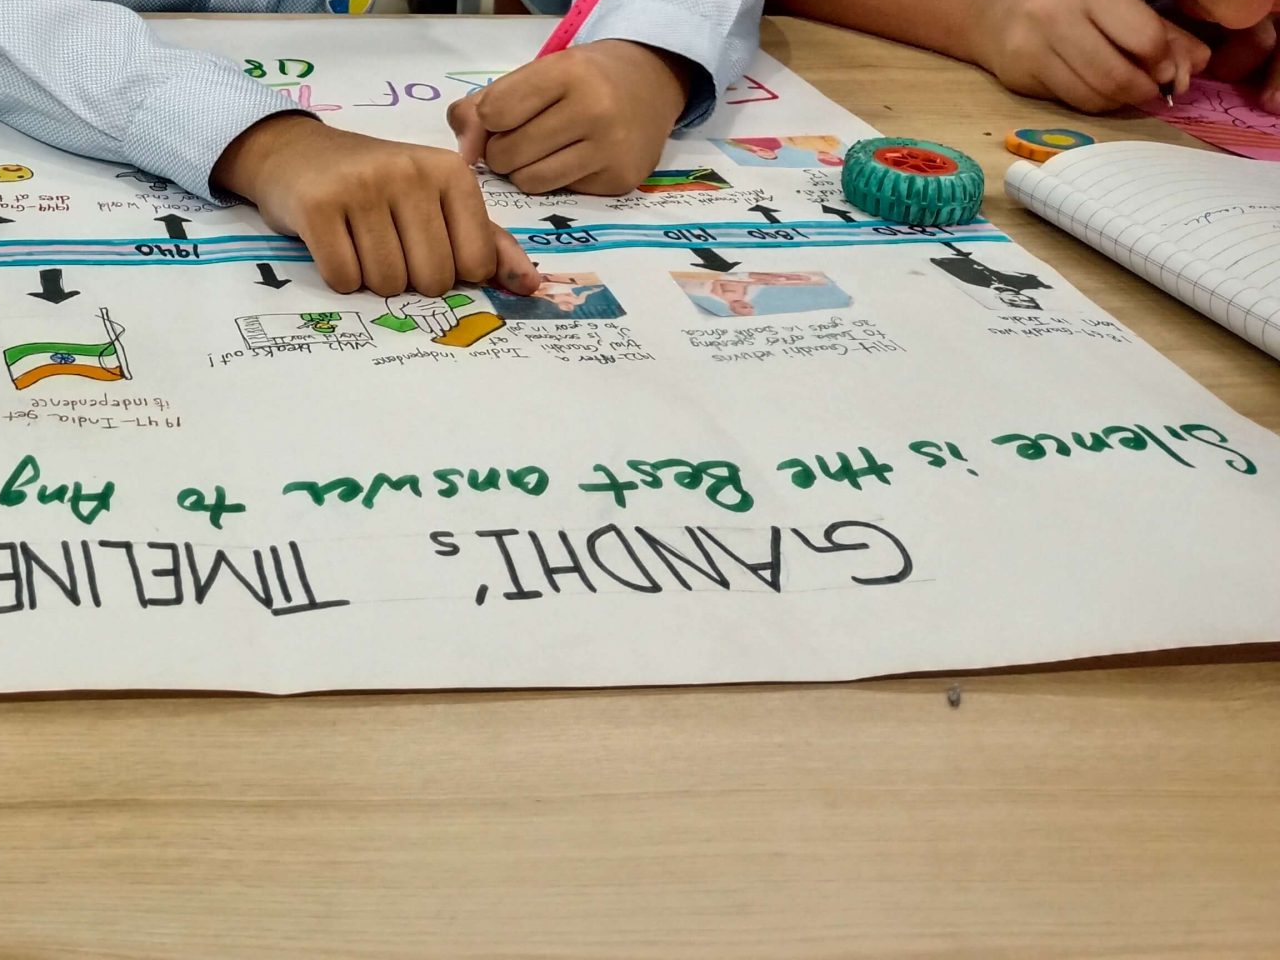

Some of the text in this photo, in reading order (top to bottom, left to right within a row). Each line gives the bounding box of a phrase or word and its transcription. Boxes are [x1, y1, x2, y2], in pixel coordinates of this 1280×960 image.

[14, 194, 29, 203] at
[39, 195, 70, 204] dies
[134, 243, 200, 259] 1940
[528, 230, 598, 246] 1920
[468, 347, 529, 359] Indian
[30, 393, 148, 411] independence
[1, 410, 39, 427] get
[909, 440, 979, 477] is
[991, 424, 1258, 475] Silence
[776, 447, 894, 491] the
[282, 465, 549, 511] answer
[578, 459, 754, 513] Best
[176, 485, 246, 529] to
[429, 520, 914, 606] GANDHI's
